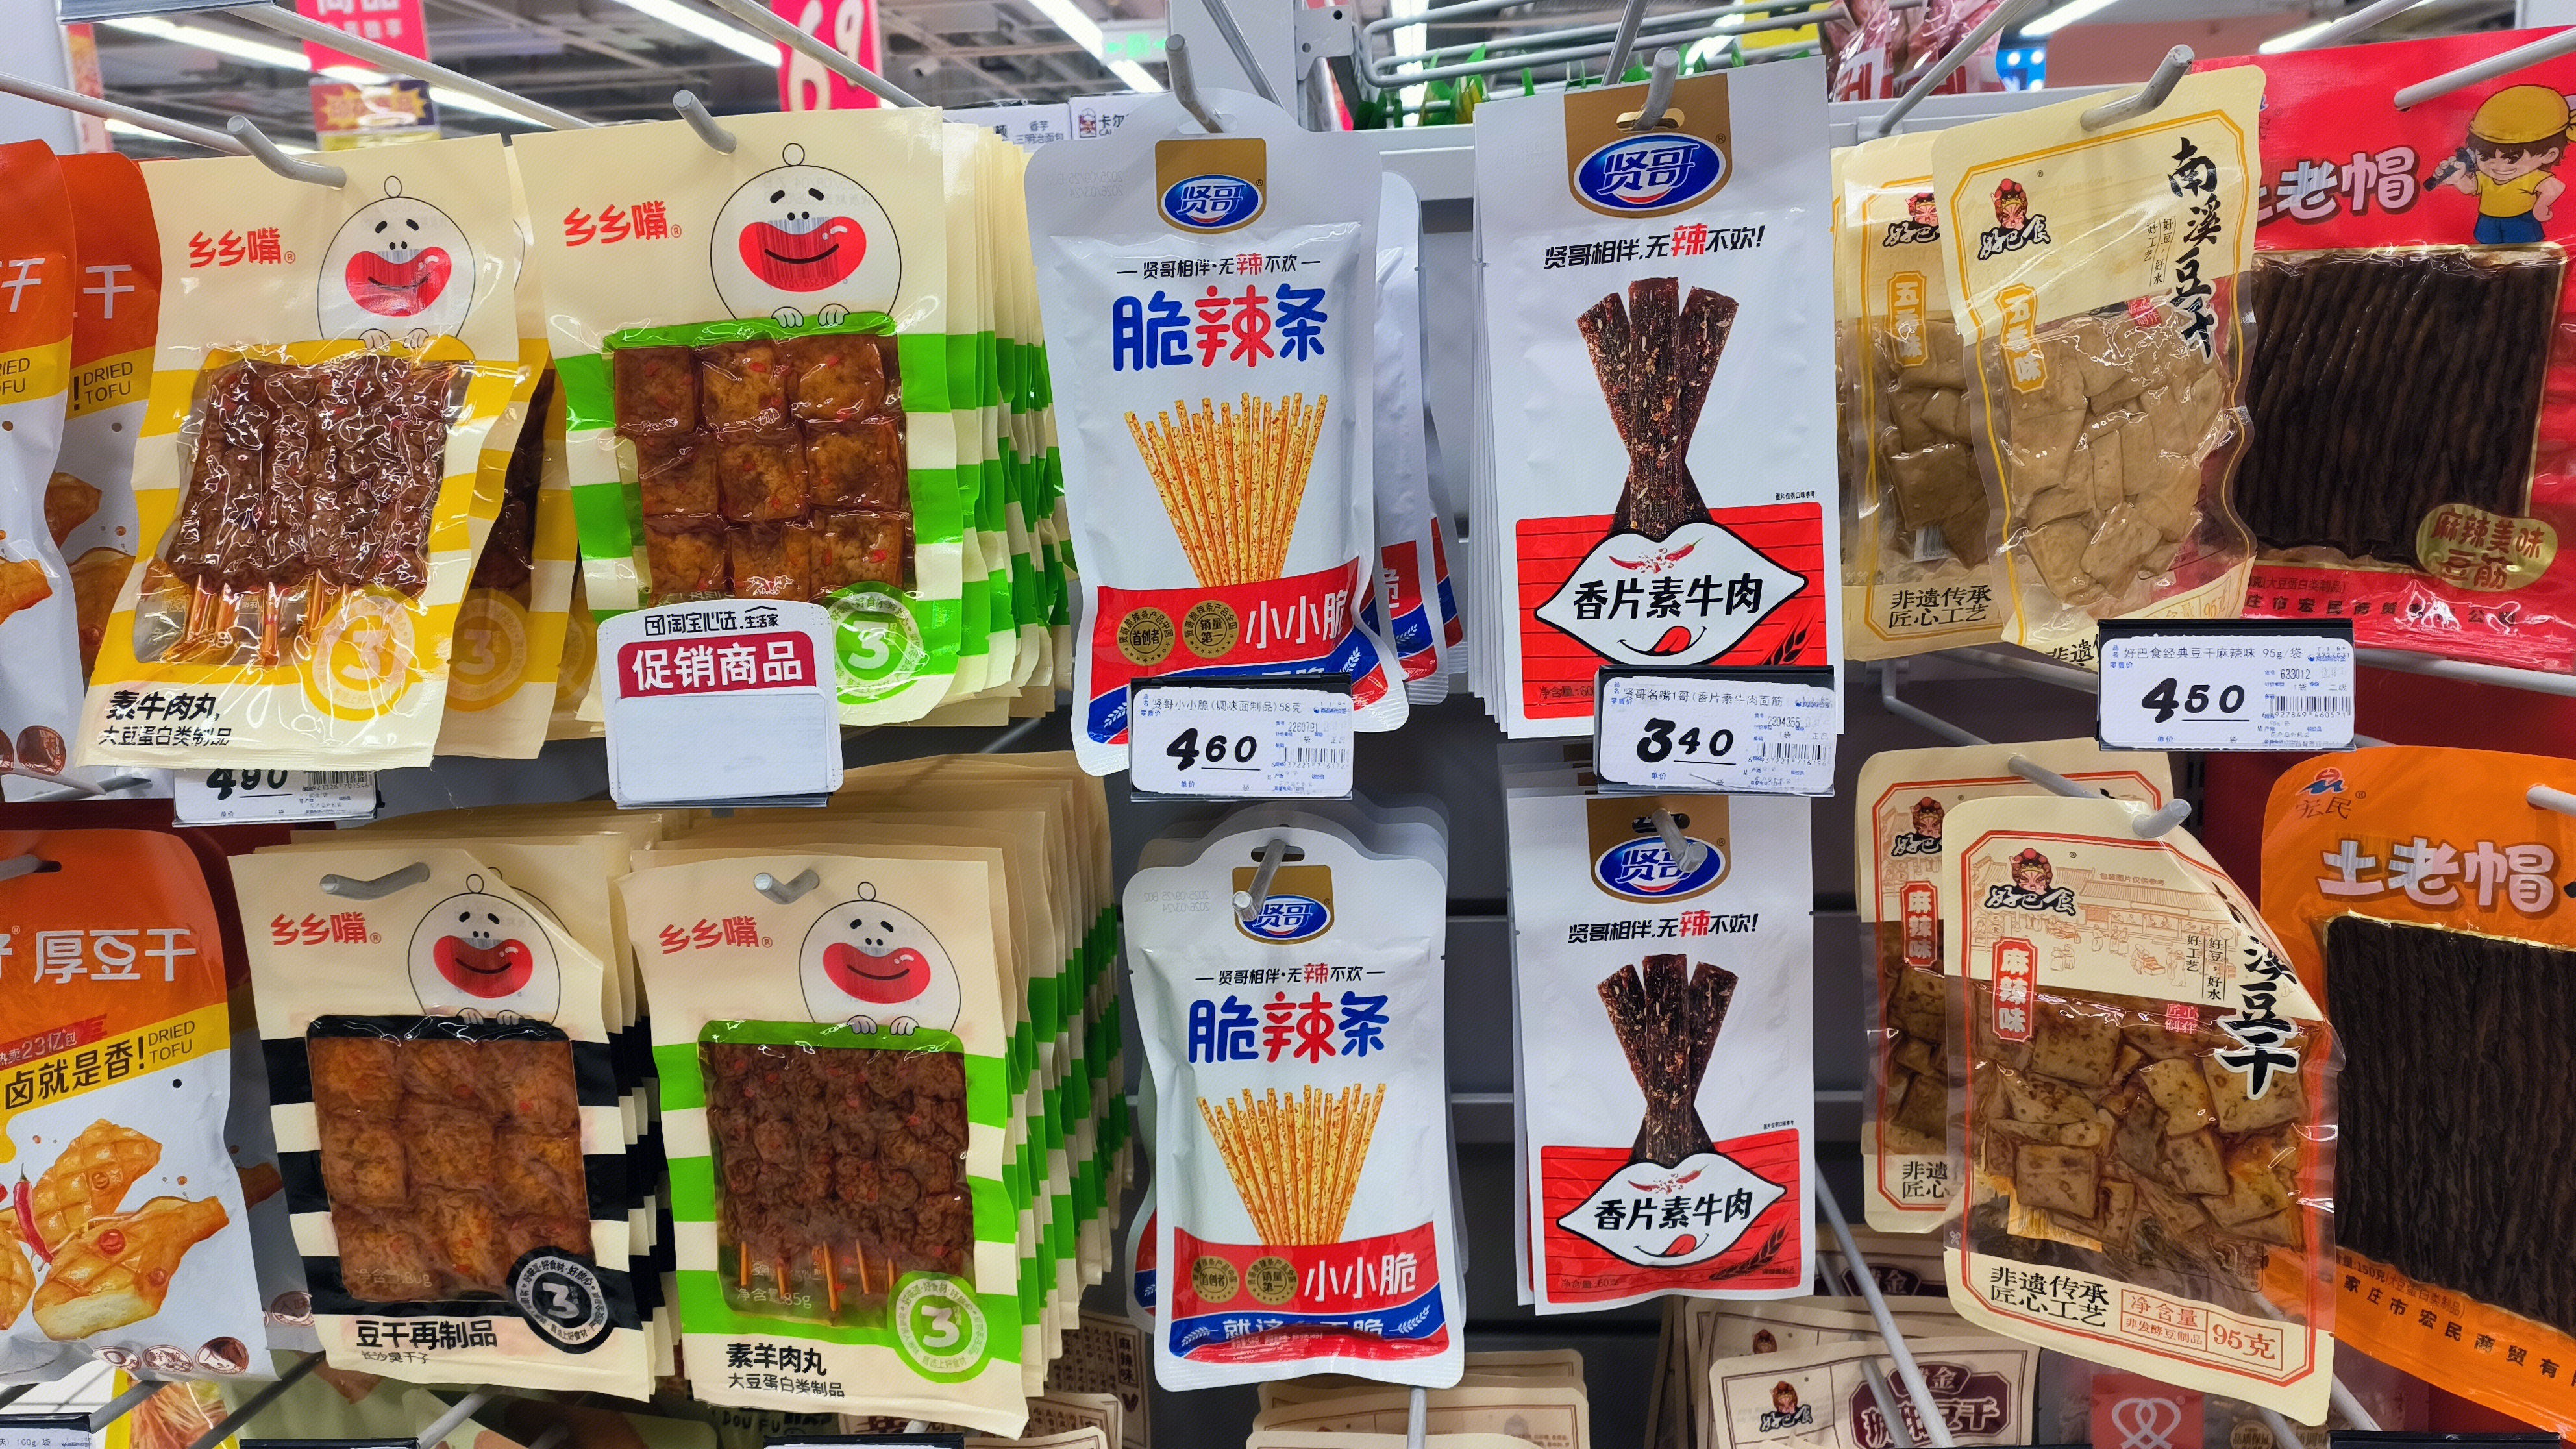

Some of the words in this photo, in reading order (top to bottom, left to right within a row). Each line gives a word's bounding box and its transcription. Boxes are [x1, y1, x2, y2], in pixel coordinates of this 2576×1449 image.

[1596, 142, 1700, 195] 贤哥
[1176, 183, 1246, 216] 贤哥
[564, 200, 669, 247] 乡乡嘴
[188, 227, 282, 267] 乡乡嘴
[1112, 282, 1328, 372] 脆辣条
[84, 361, 134, 386] DRIED
[84, 381, 131, 405] TOFU
[2430, 509, 2545, 560] 麻辣美味
[1573, 572, 1764, 621] 香片素牛肉
[1889, 604, 1990, 629] 匠心工艺
[1891, 584, 1992, 609] 非遗传承
[1245, 589, 1348, 649] 小小脆
[631, 640, 803, 692] 促销商品
[2280, 669, 2310, 680] 633012
[2318, 837, 2555, 913] 土老帽
[271, 911, 368, 947] 乡乡嘴
[658, 915, 761, 955] 乡乡嘴
[1252, 902, 1315, 930] 贤哥
[1906, 889, 1933, 960] 麻辣味
[34, 928, 197, 985] 厚豆干
[1999, 947, 2028, 1033] 麻辣味
[148, 1021, 195, 1047] DRIED
[1187, 990, 1390, 1064] 脆辣条
[149, 1039, 193, 1064] TOFU
[1593, 1187, 1753, 1232] 香片素牛肉
[1303, 1252, 1418, 1303] 小小脆
[1990, 1266, 2110, 1306] 非遗传承
[1990, 1284, 2107, 1329] 匠心工艺
[2131, 1296, 2199, 1328] 净含量
[356, 1319, 498, 1350] 豆干再制品
[2212, 1324, 2277, 1361] 95克
[726, 1342, 828, 1376] 素羊肉丸
[727, 1372, 845, 1399] 大豆蛋白类制品
